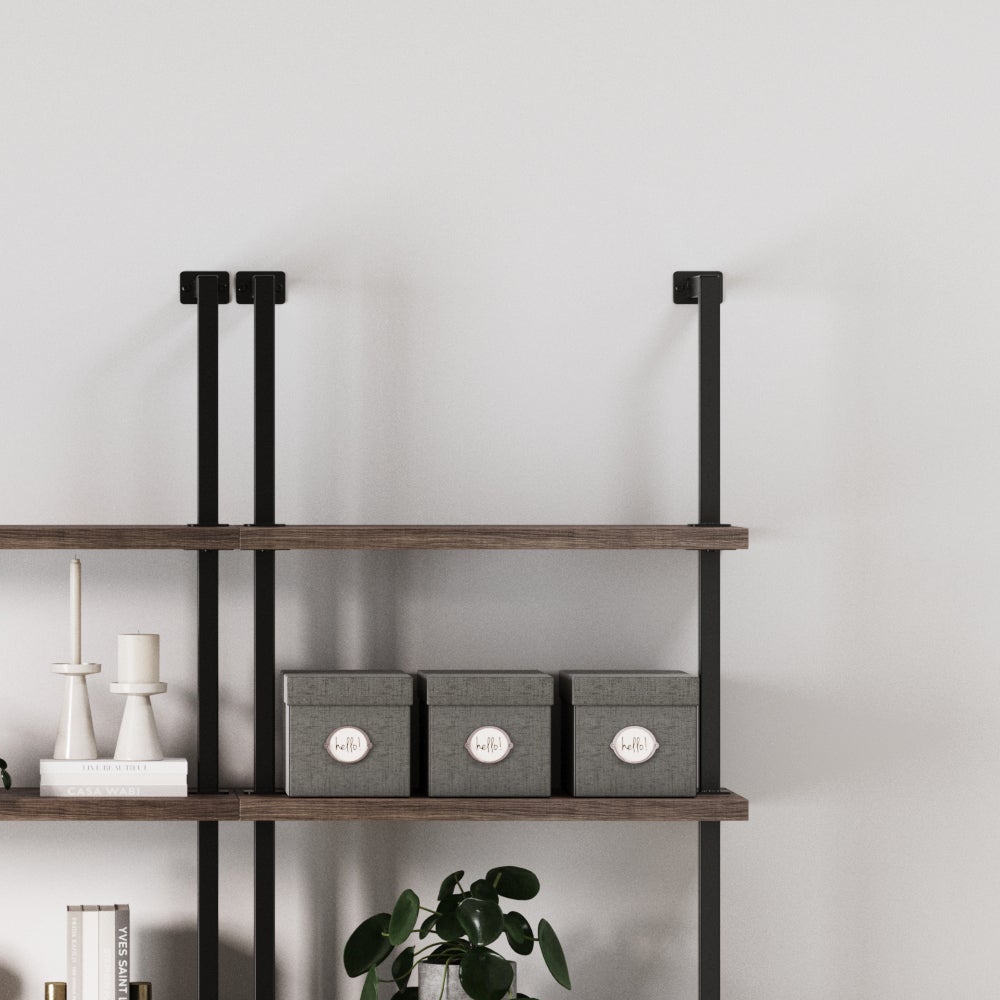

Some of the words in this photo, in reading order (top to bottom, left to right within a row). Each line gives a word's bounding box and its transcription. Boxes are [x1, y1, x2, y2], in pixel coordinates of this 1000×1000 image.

[335, 736, 362, 753] hello!
[476, 736, 503, 753] hello!
[621, 736, 648, 753] hello!
[67, 786, 102, 796] CASA
[106, 786, 140, 796] WABI
[118, 926, 128, 956] YVES
[118, 961, 128, 993] SAINT
